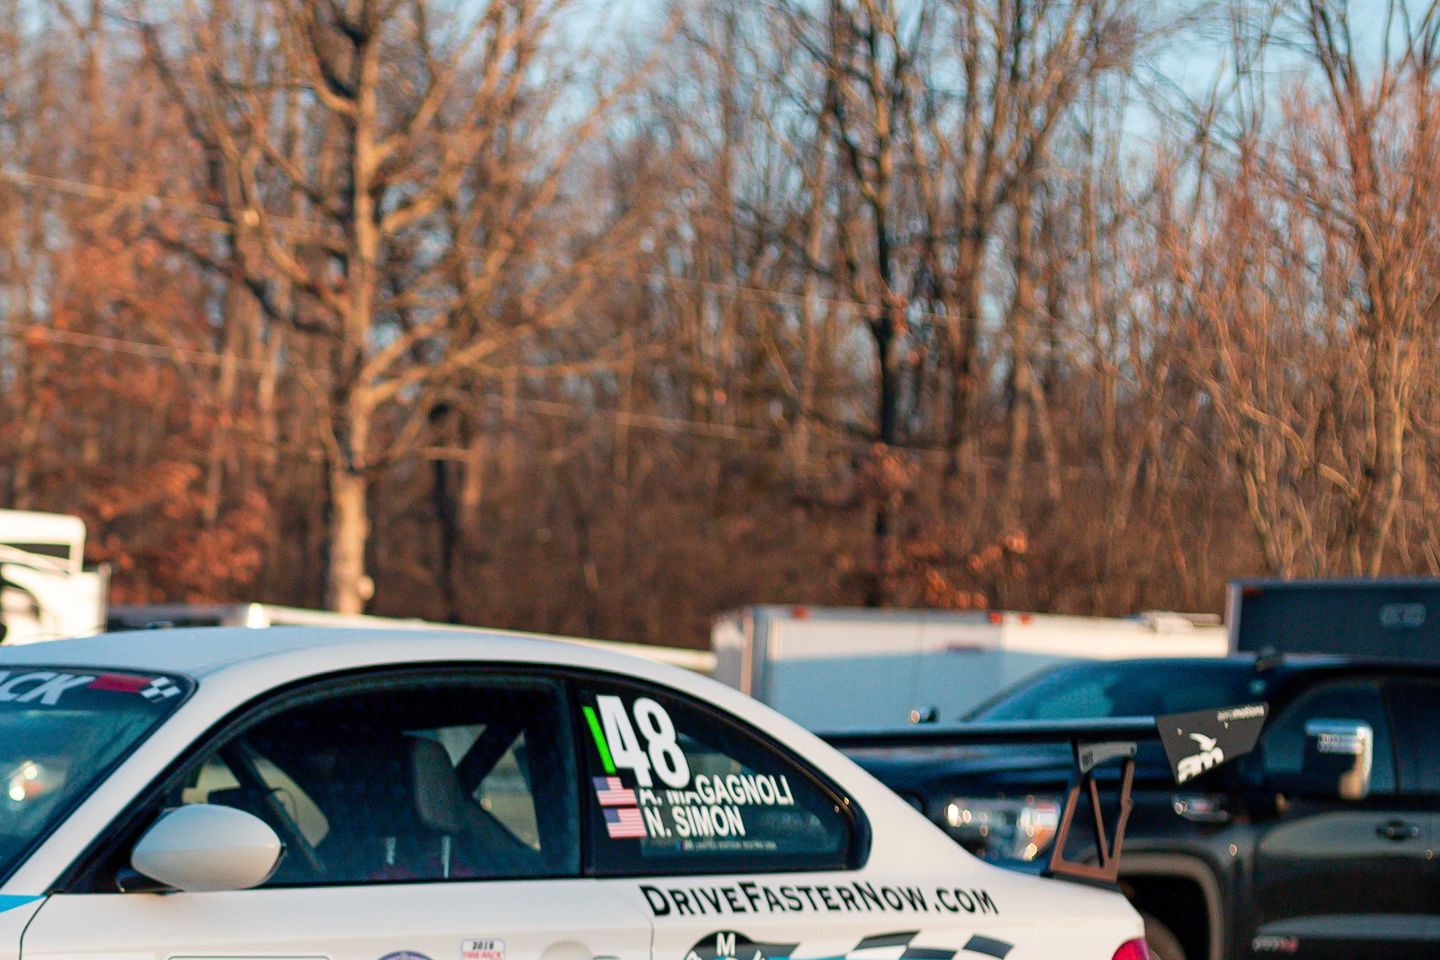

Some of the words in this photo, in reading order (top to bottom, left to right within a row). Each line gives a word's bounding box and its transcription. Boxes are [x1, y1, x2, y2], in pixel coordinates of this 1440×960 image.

[596, 694, 691, 788] 48
[643, 806, 673, 839] N.
[671, 805, 746, 838] SIMON
